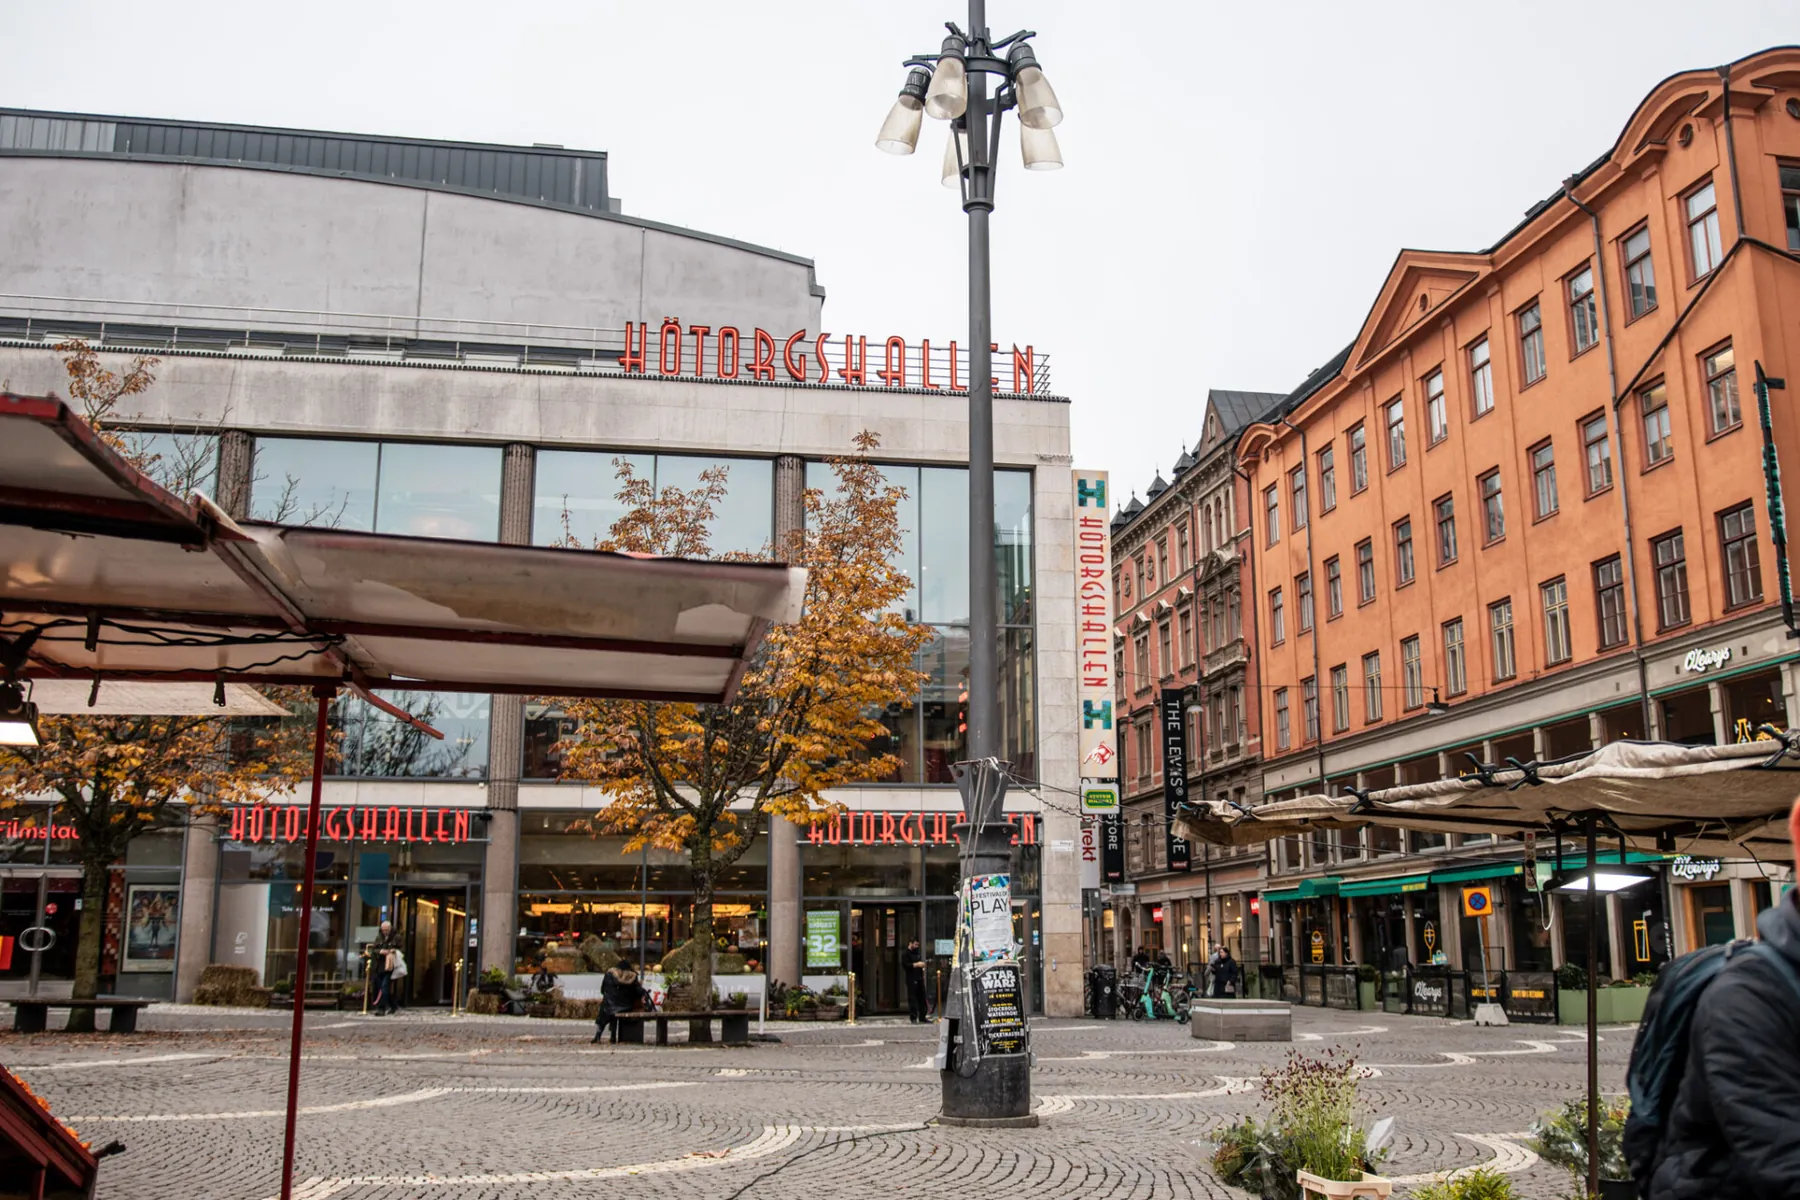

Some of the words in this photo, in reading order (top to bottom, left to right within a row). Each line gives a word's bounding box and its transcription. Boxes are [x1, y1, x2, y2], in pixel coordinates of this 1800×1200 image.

[1079, 516, 1108, 687] HÖTORGSHALLEN
[1167, 700, 1180, 731] THE
[971, 898, 1008, 915] PLAY
[809, 934, 837, 953] 32
[981, 970, 1015, 980] STAR
[981, 979, 1016, 989] WARS
